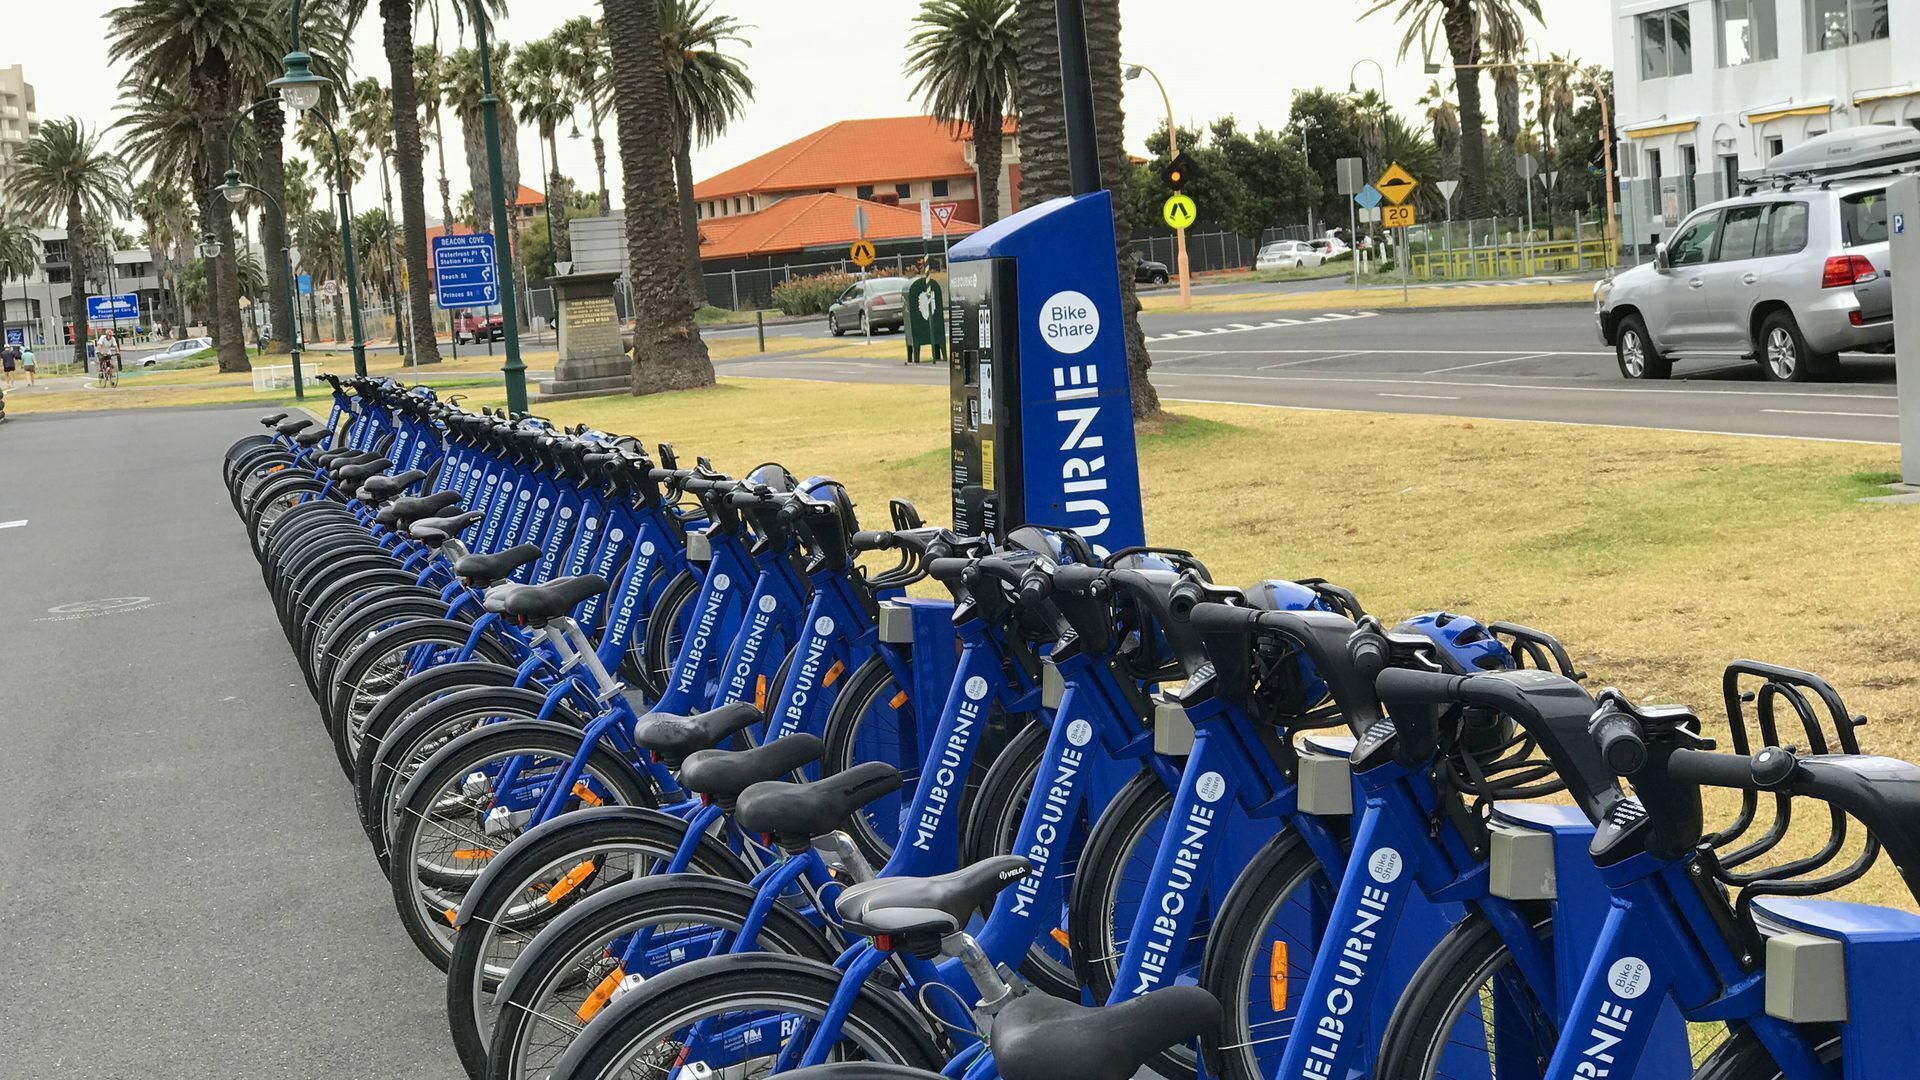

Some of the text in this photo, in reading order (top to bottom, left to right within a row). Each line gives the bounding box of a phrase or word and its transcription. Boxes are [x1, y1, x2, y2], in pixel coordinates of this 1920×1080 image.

[1390, 208, 1408, 220] 20
[1895, 215, 1902, 232] P
[441, 236, 485, 246] BEACON COVE
[1052, 306, 1087, 321] Bike
[1047, 323, 1094, 338] Share
[480, 492, 508, 554] MELBOURNE
[610, 556, 650, 646] MELBOURNE
[676, 590, 724, 694] MELBOURNE
[724, 612, 770, 706] ELBOURNE
[778, 636, 828, 739] ELBOURNE
[969, 680, 978, 694] Bike
[974, 680, 984, 697] Share
[1071, 724, 1081, 739] Bike
[1077, 723, 1088, 744] Share
[912, 700, 979, 850] MELBOURNE
[1201, 776, 1212, 794] Bike
[1208, 776, 1220, 800] Share
[1010, 748, 1082, 918] MELBOURNE
[1375, 854, 1388, 874] Bike
[1382, 853, 1397, 880] Share
[1132, 804, 1214, 996] MELBOURNE
[1616, 964, 1632, 988] Bike
[1625, 964, 1644, 995] Share
[781, 1018, 800, 1036] RA
